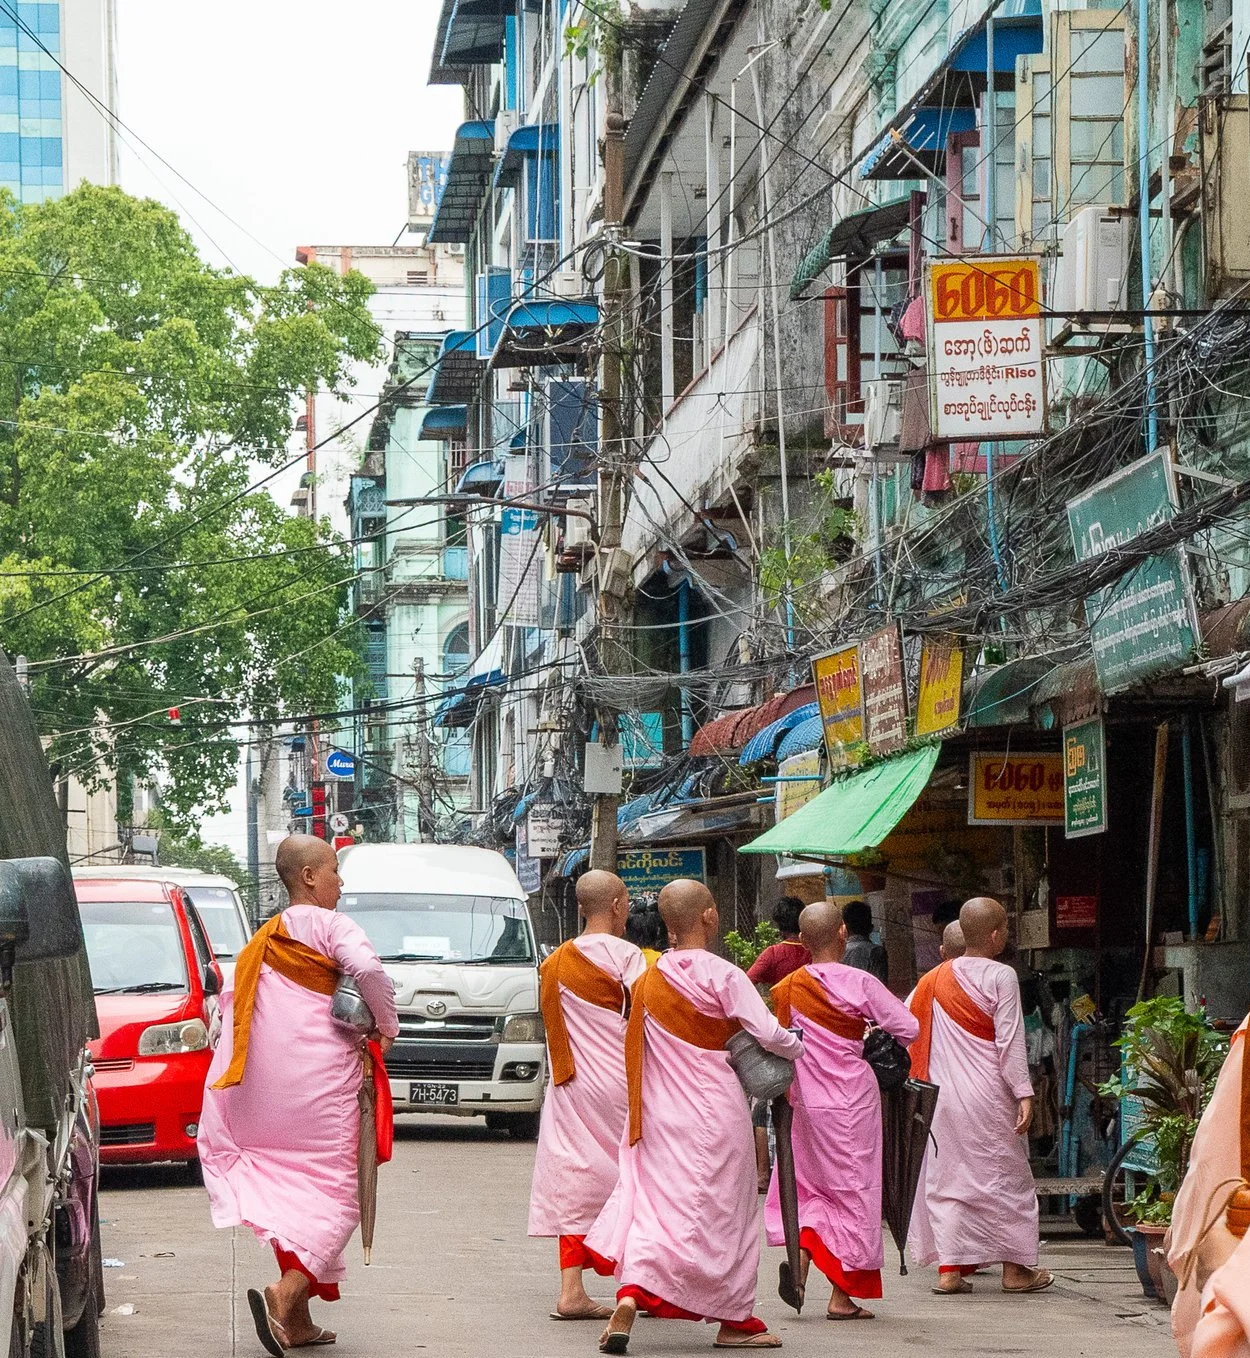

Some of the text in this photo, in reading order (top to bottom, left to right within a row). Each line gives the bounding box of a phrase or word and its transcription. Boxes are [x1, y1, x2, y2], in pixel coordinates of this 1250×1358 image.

[936, 268, 1034, 318] ဝေဝေ
[1005, 367, 1036, 379] Riso
[412, 1087, 456, 1101] 7H-5473
